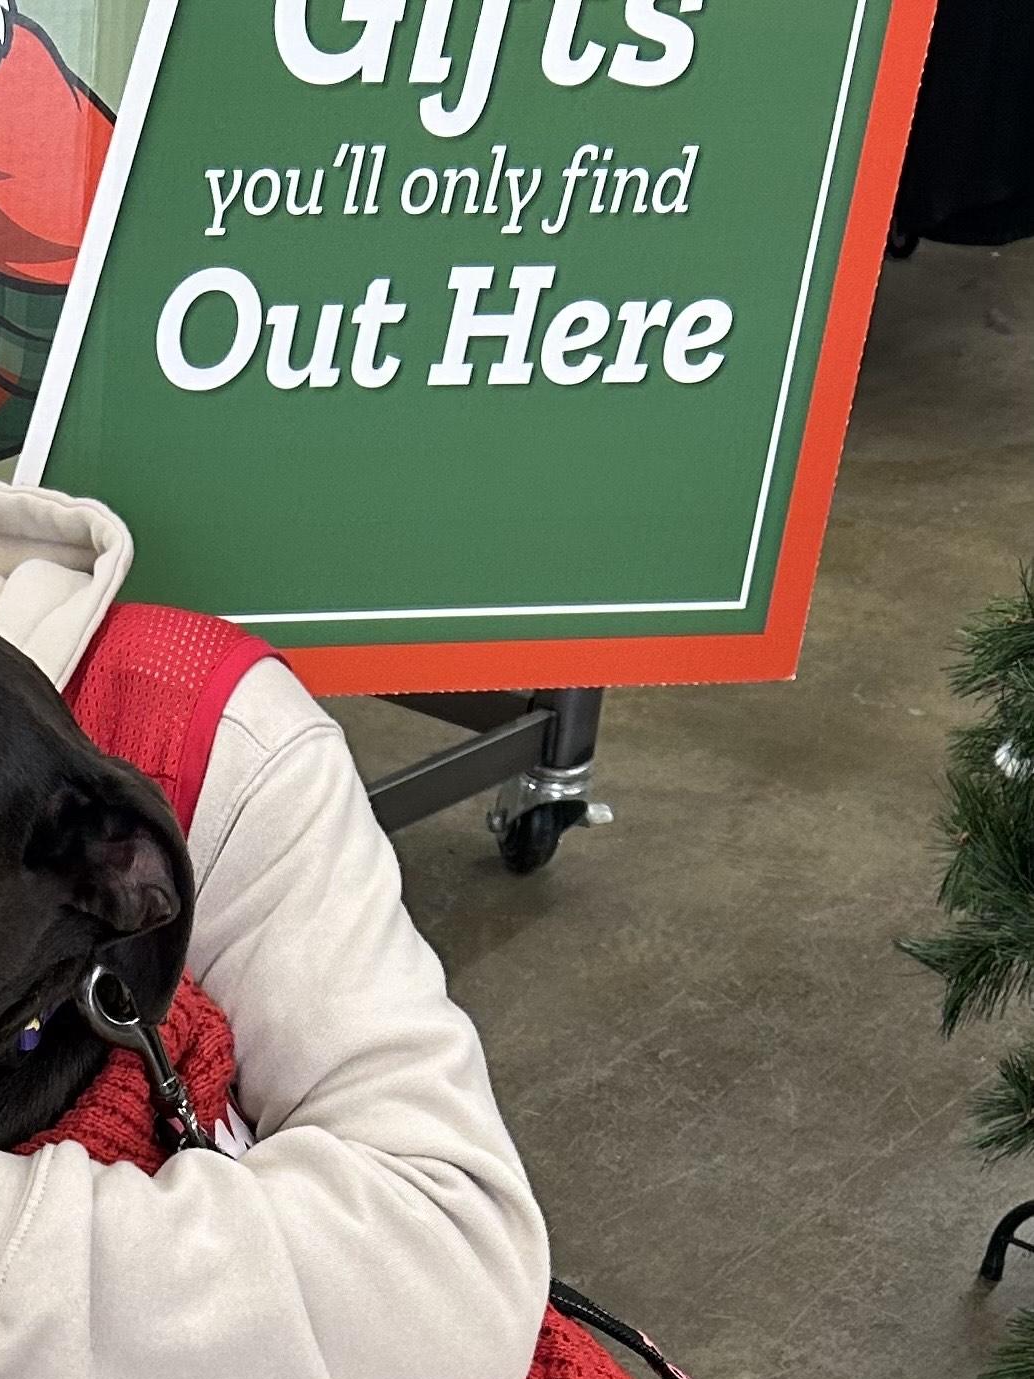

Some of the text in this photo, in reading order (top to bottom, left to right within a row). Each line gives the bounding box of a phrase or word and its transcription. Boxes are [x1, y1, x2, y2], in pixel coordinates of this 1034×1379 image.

[204, 143, 700, 237] you'll only find
[155, 264, 734, 392] Out Here
